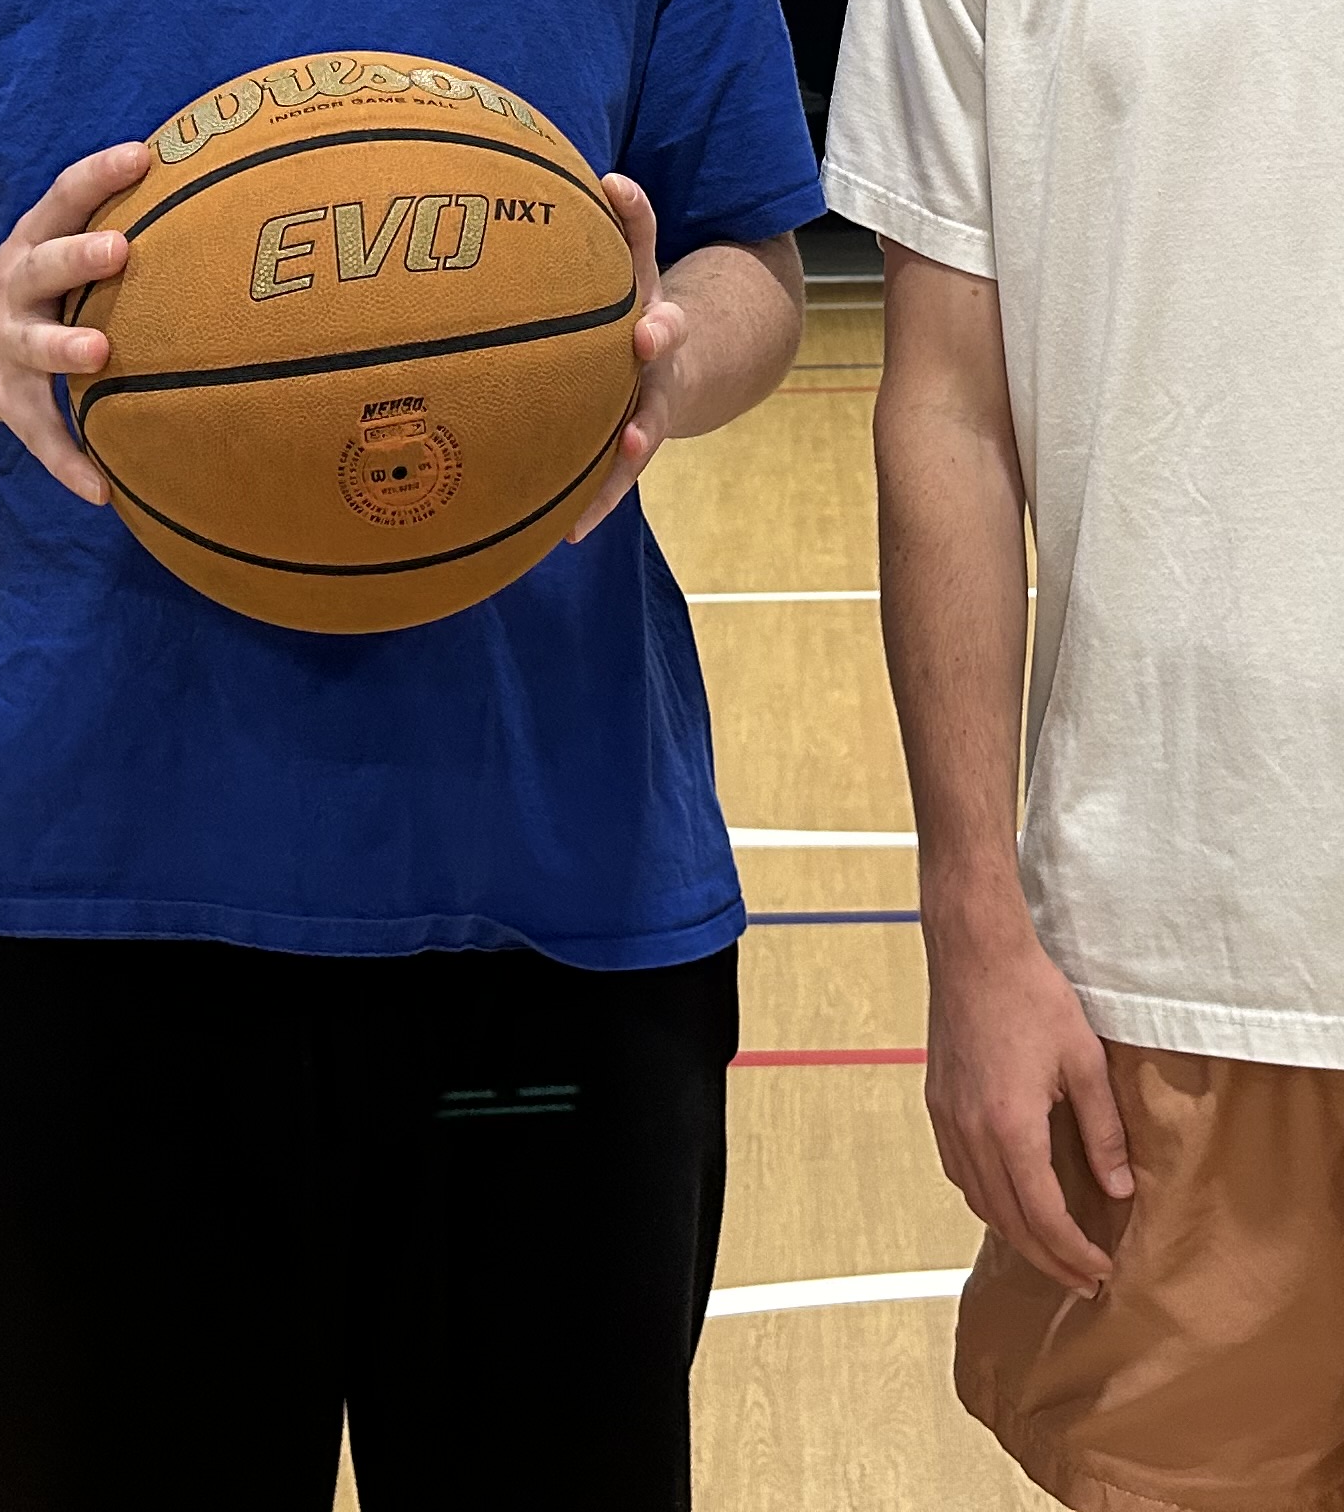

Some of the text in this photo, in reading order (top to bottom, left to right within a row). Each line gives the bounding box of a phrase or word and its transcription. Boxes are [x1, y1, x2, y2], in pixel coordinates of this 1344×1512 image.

[148, 55, 543, 164] Wilson
[269, 96, 458, 125] INDOOR GAME BALL
[250, 194, 556, 302] EVO NXT
